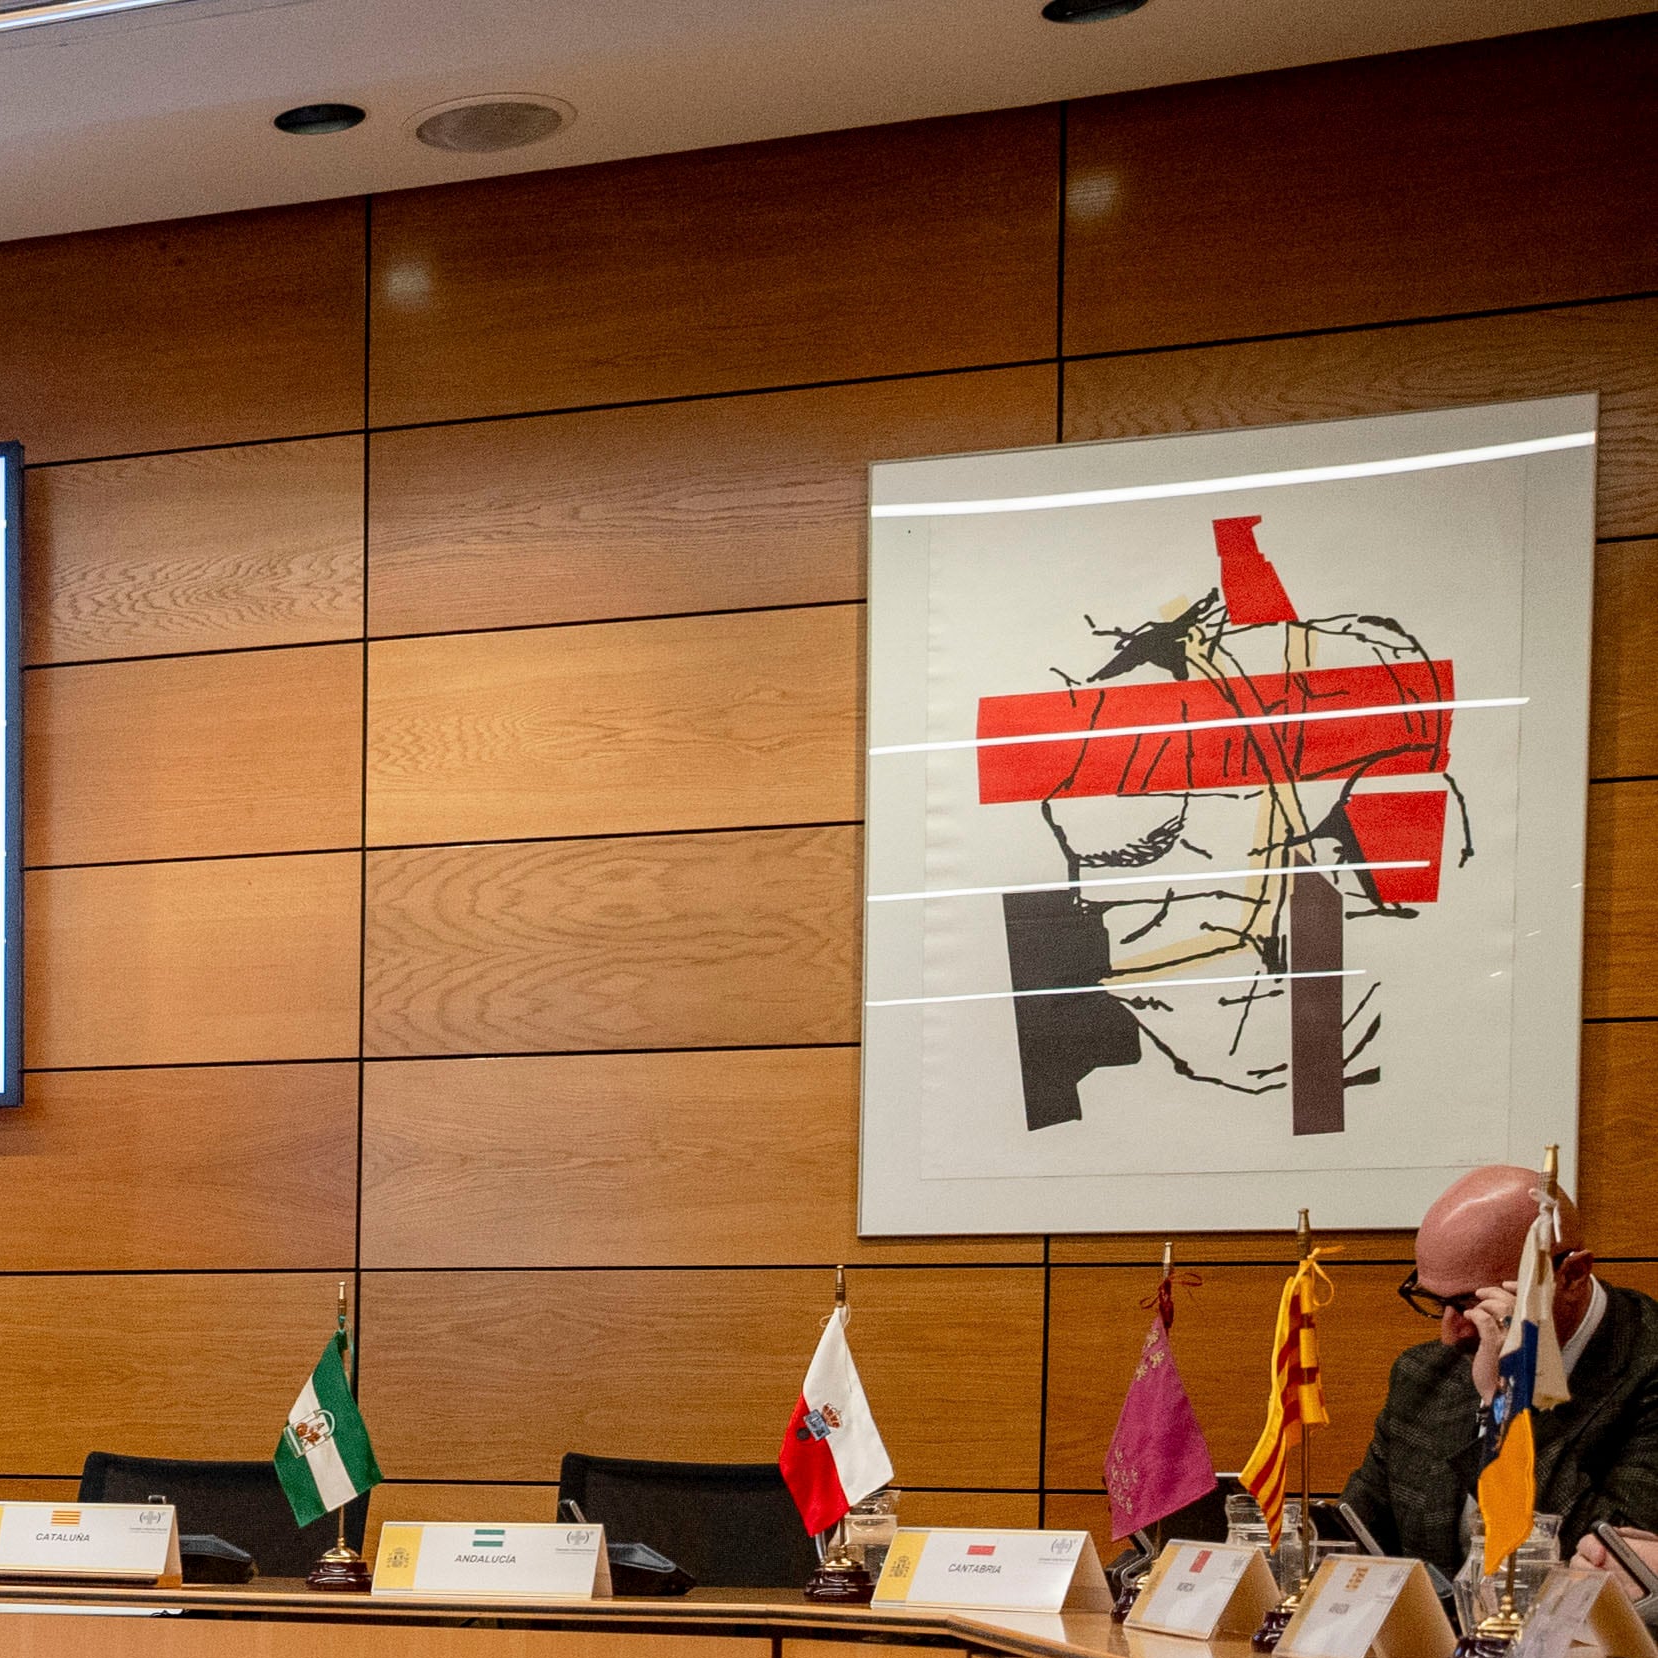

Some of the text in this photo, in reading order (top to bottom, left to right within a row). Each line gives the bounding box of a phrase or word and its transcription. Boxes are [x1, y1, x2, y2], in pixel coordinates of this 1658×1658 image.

[35, 1531, 91, 1542] CATALUÑA
[454, 1553, 517, 1564] ANDALUCÍA
[947, 1563, 1003, 1574] CANTABRIA
